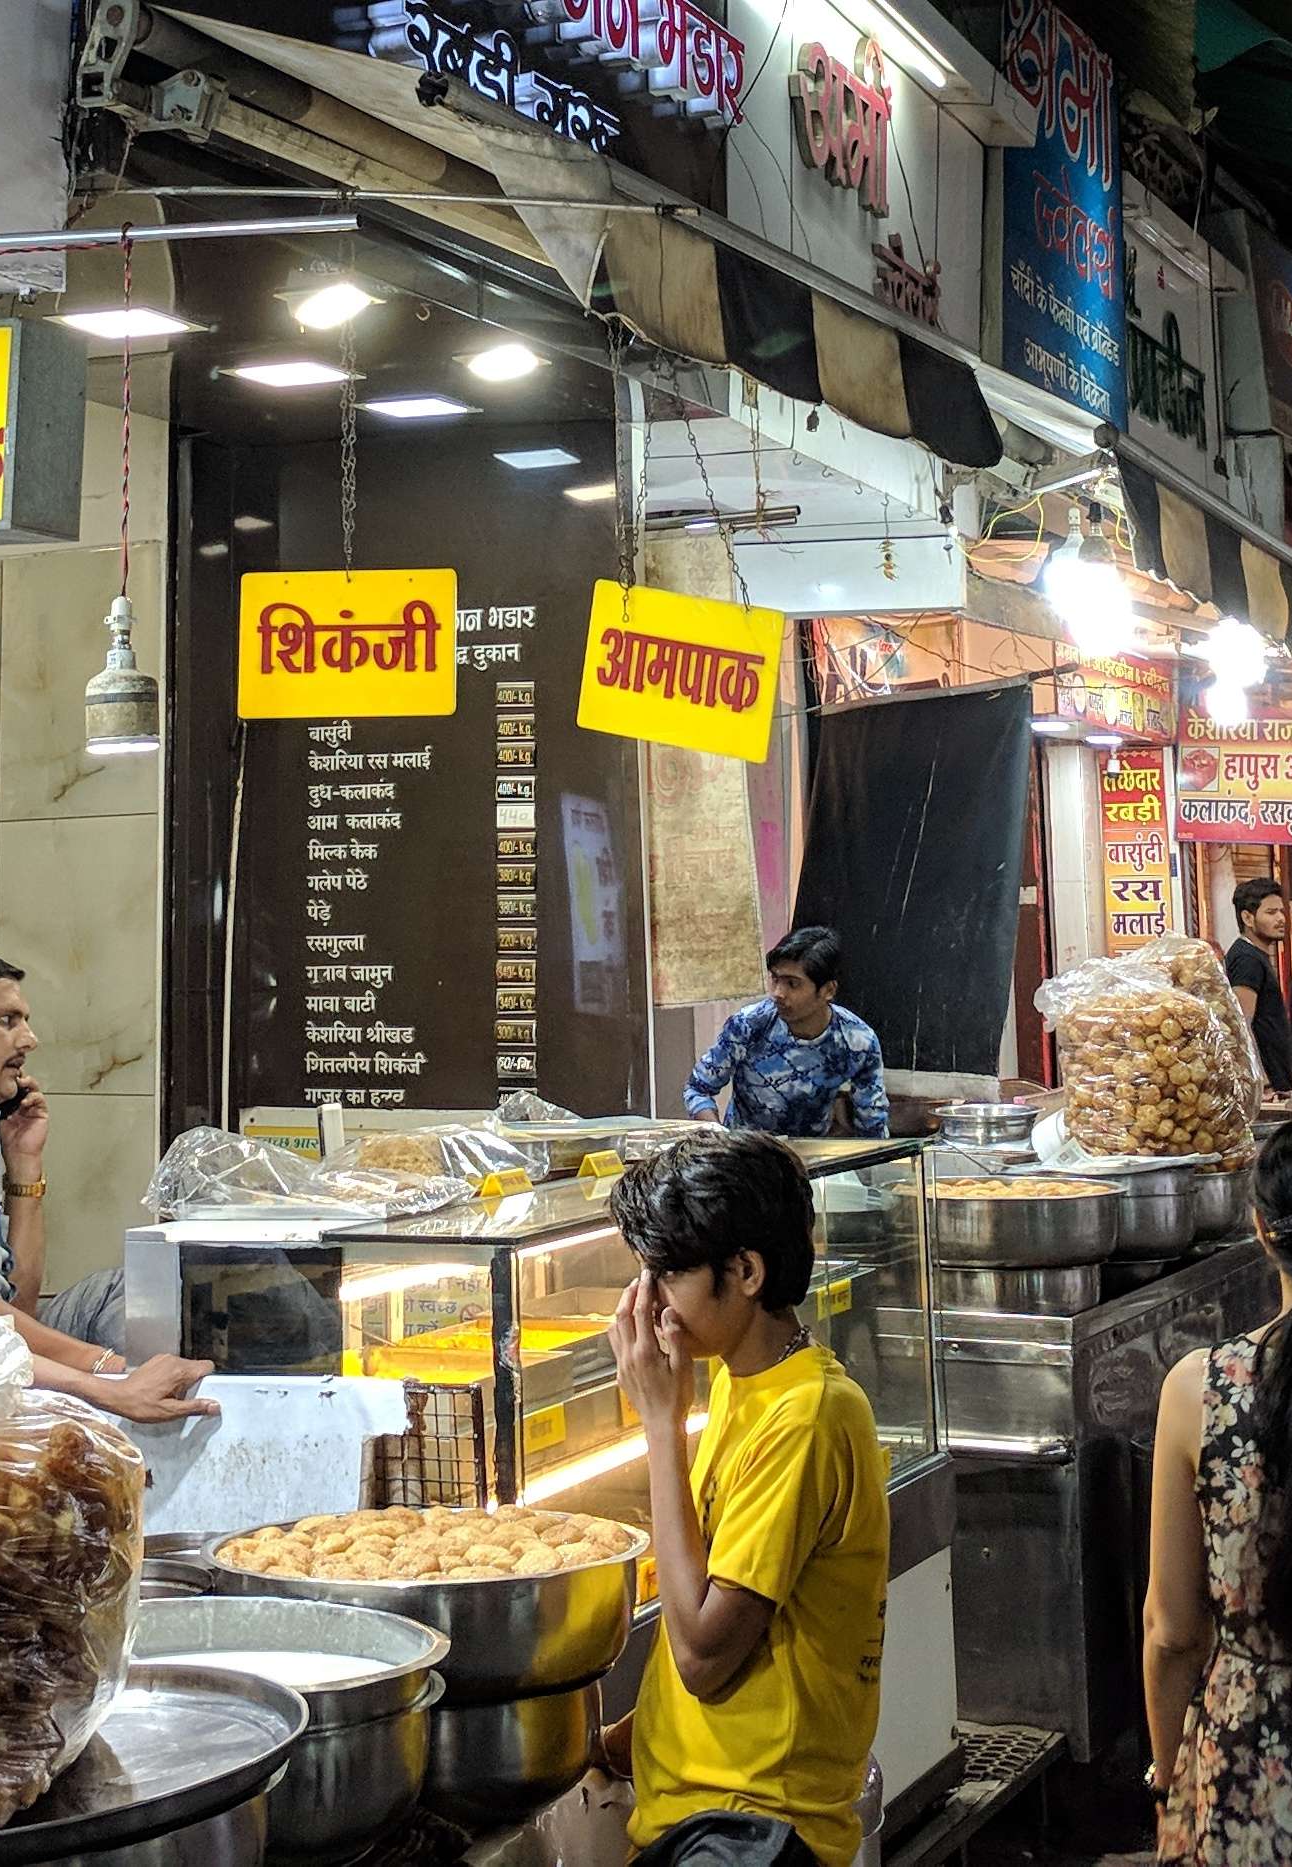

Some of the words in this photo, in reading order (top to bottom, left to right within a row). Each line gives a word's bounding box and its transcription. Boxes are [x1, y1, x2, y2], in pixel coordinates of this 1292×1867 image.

[257, 600, 442, 675] शिकंजी
[472, 644, 523, 671] दुकान
[596, 627, 766, 713] आमपाक
[308, 720, 352, 748] बासुंदी
[308, 749, 364, 771] केशरिया
[366, 753, 389, 769] रस
[391, 745, 432, 770] मलाई
[1223, 753, 1282, 790] हापुस
[307, 815, 339, 830] आम
[345, 807, 402, 830] कलाकंद
[1105, 794, 1162, 827] रबड़ी
[307, 839, 348, 860] मिल्क
[349, 838, 379, 860] केक
[1106, 833, 1164, 873] बासुंदी
[1111, 880, 1163, 902] रस
[306, 899, 333, 927] पेड़े
[1112, 902, 1167, 939] मलाई
[306, 934, 367, 958] रसगुल्ला
[348, 965, 395, 988] जामुन
[305, 996, 340, 1013] मावा
[342, 989, 376, 1013] बाटी
[305, 1020, 362, 1044] केशरिया
[345, 1088, 367, 1105] का
